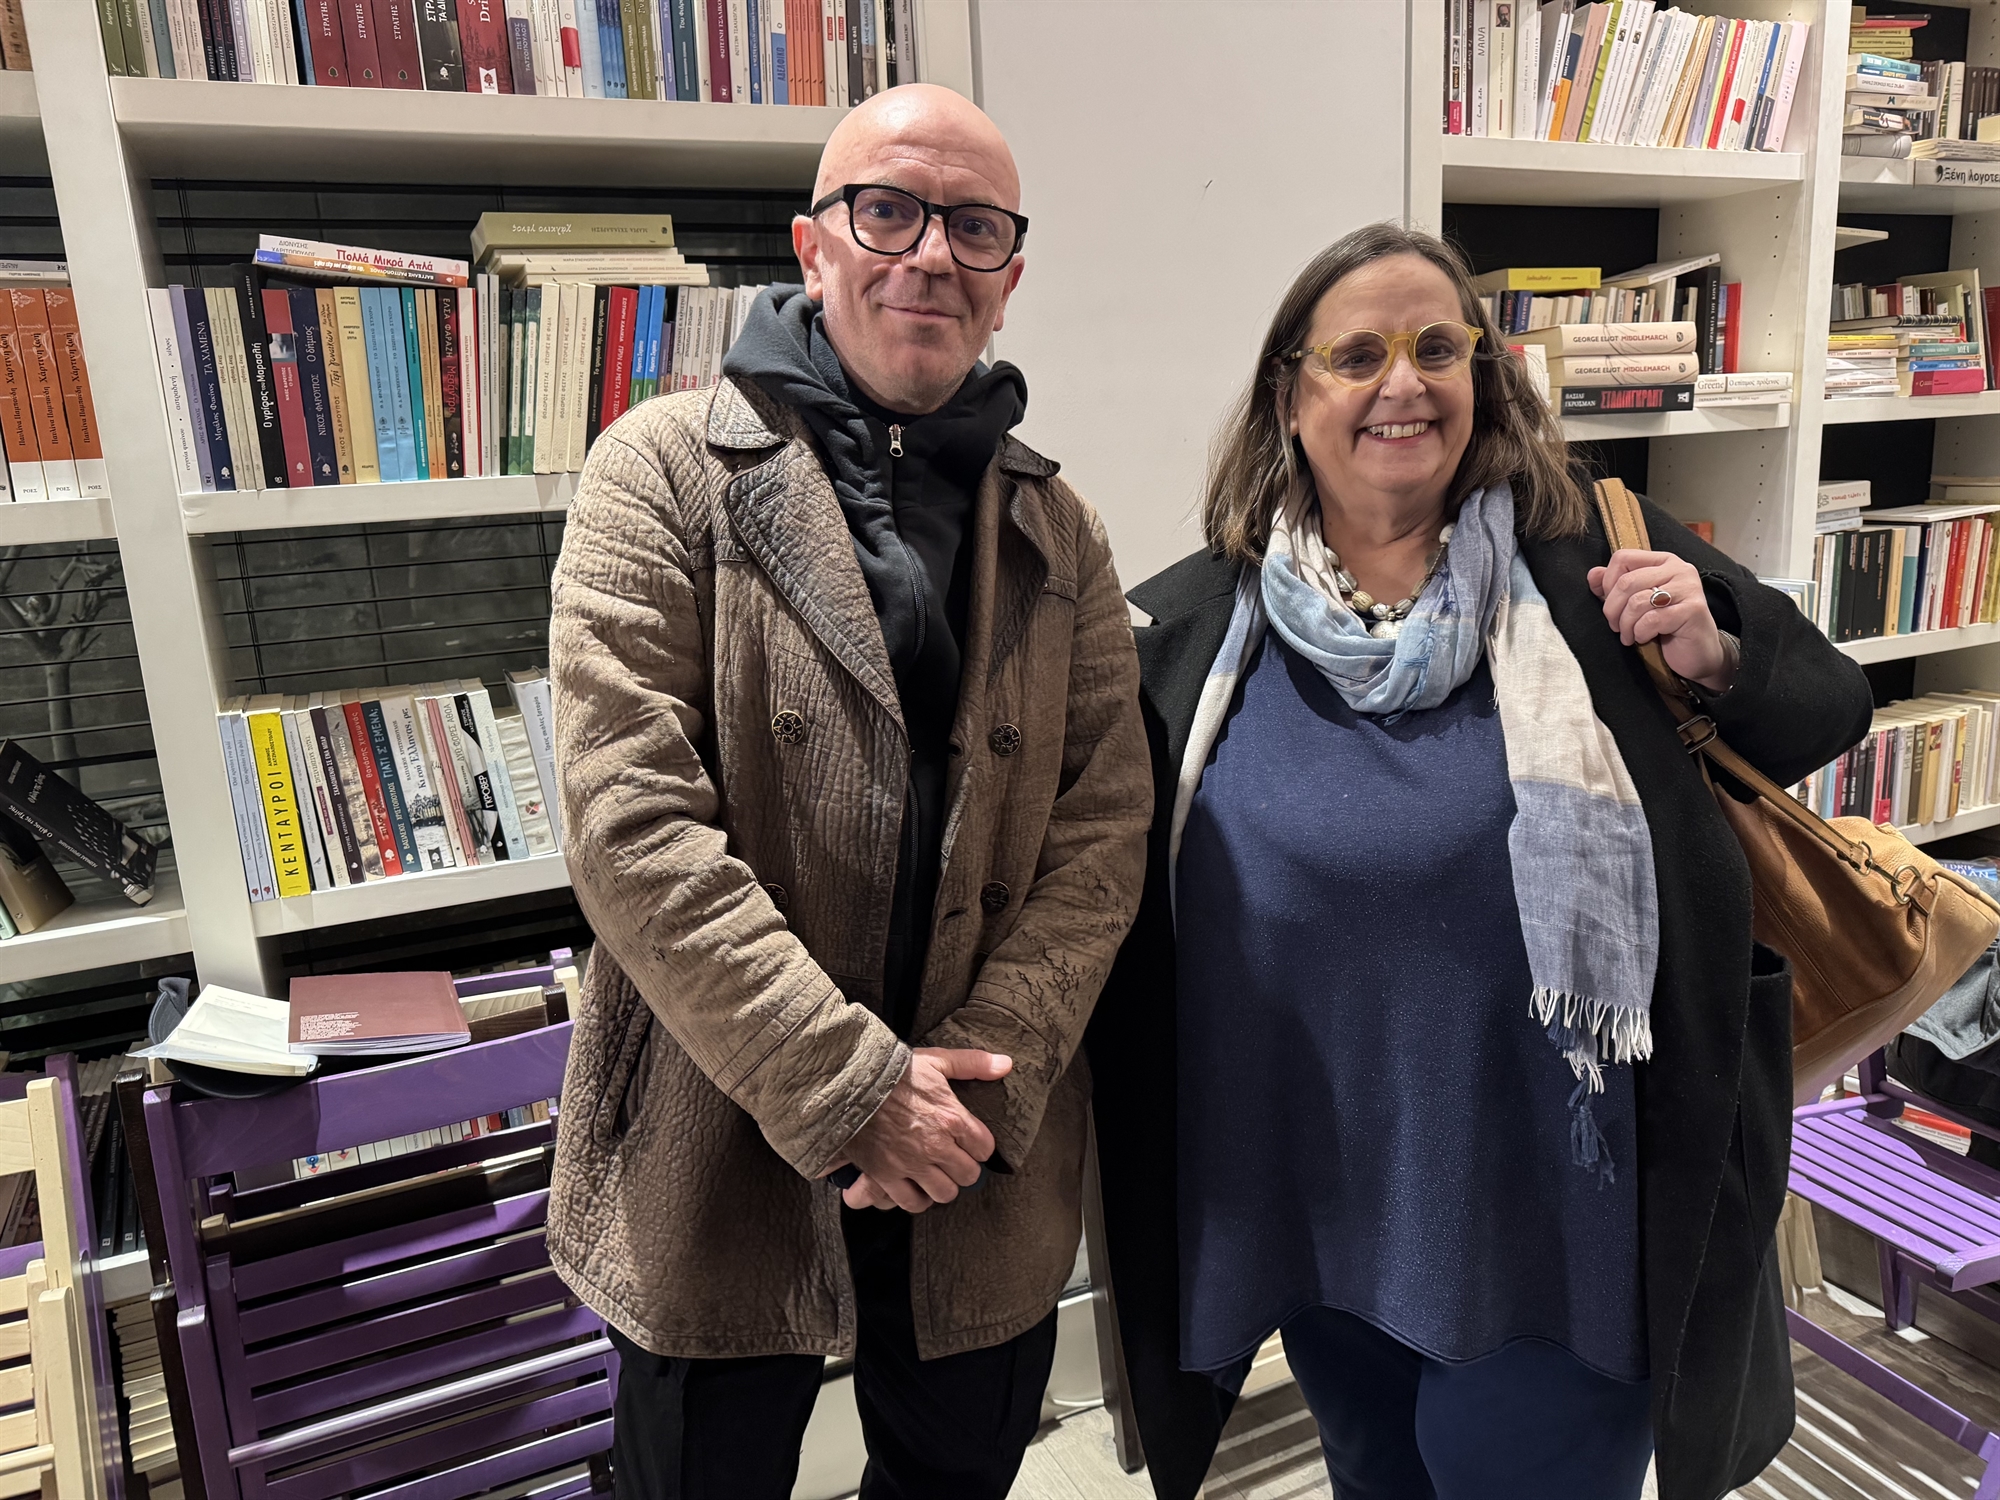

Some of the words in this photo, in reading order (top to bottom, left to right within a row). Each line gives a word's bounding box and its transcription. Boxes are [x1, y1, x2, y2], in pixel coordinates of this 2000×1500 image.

[320, 1, 332, 37] ΣΤΡΑΤΗΣ
[355, 3, 367, 39] ΣΤΡΑΤΗΣ
[390, 5, 402, 40] ΣΤΡΑΤΗΣ
[514, 22, 522, 50] ΠΕΤΡΟΣ
[776, 47, 786, 82] ΑΔΕΛΦΙΚΟ
[1944, 167, 1966, 184] Ξένη
[538, 223, 572, 235] χάλκινο
[336, 249, 370, 264] Πολλά
[373, 254, 404, 268] Μικρά
[408, 260, 434, 272] Απλά
[442, 298, 450, 320] ΕΛΣΑ
[197, 321, 211, 361] ΧΑΜΕΝΑ
[444, 323, 453, 358] ΦΑΡΑΖΗ
[616, 345, 624, 360] ΠΡΙΝ
[1572, 335, 1599, 343] GEORGE
[1600, 334, 1618, 342] ELIOT
[1620, 334, 1669, 342] MIDDLEMARCH
[3, 350, 15, 384] Χάρτινη
[36, 350, 48, 383] Χάρτινη
[68, 349, 81, 382] Χάρτινη
[203, 363, 213, 375] ΤΑ
[251, 342, 267, 382] Μαρασλή
[1602, 366, 1621, 374] ELIOT
[1623, 365, 1671, 373] MIDDLEMARCH
[207, 383, 218, 411] Φακίνος
[311, 374, 324, 412] ΦΑΡΟΥΠΟΣ
[446, 365, 460, 413] Μεσάντρα
[614, 390, 620, 399] ΤΑ
[1697, 380, 1725, 391] Greene
[259, 391, 274, 420] γρίφος
[334, 396, 343, 434] ΦΑΡΟΥΠΟΣ
[213, 412, 224, 441] Μιχάλης
[318, 413, 327, 436] ΝΙΚΟΣ
[339, 437, 347, 457] ΝΙΚΟΣ
[351, 712, 367, 746] χειμωνάς
[368, 708, 385, 743] ΕΜΕΝΑ;
[449, 724, 461, 748] ΦΟΡΕΣ
[320, 735, 329, 749] ΜΠΑΡ
[403, 721, 420, 764] Έλληνας,
[454, 748, 465, 762] ΔΥΟ
[265, 747, 273, 767] ΑΝΘΙΜΟΣ
[361, 747, 373, 778] θανάσης
[380, 757, 394, 778] ΓΙΑΤΙ
[328, 766, 340, 796] ΣΚΑΛΩΜΕΝΟΙ
[417, 779, 427, 789] Κι
[478, 774, 494, 808] ΓΚΡΟΒΕΡ
[387, 782, 403, 820] ΧΡΙΣΤΟΠΟΥΛΟΣ
[267, 771, 300, 876] ΚΕΝΤΑΥΡΟΙ
[398, 822, 410, 850] ΒΑΣΙΛΕΙΟΣ
